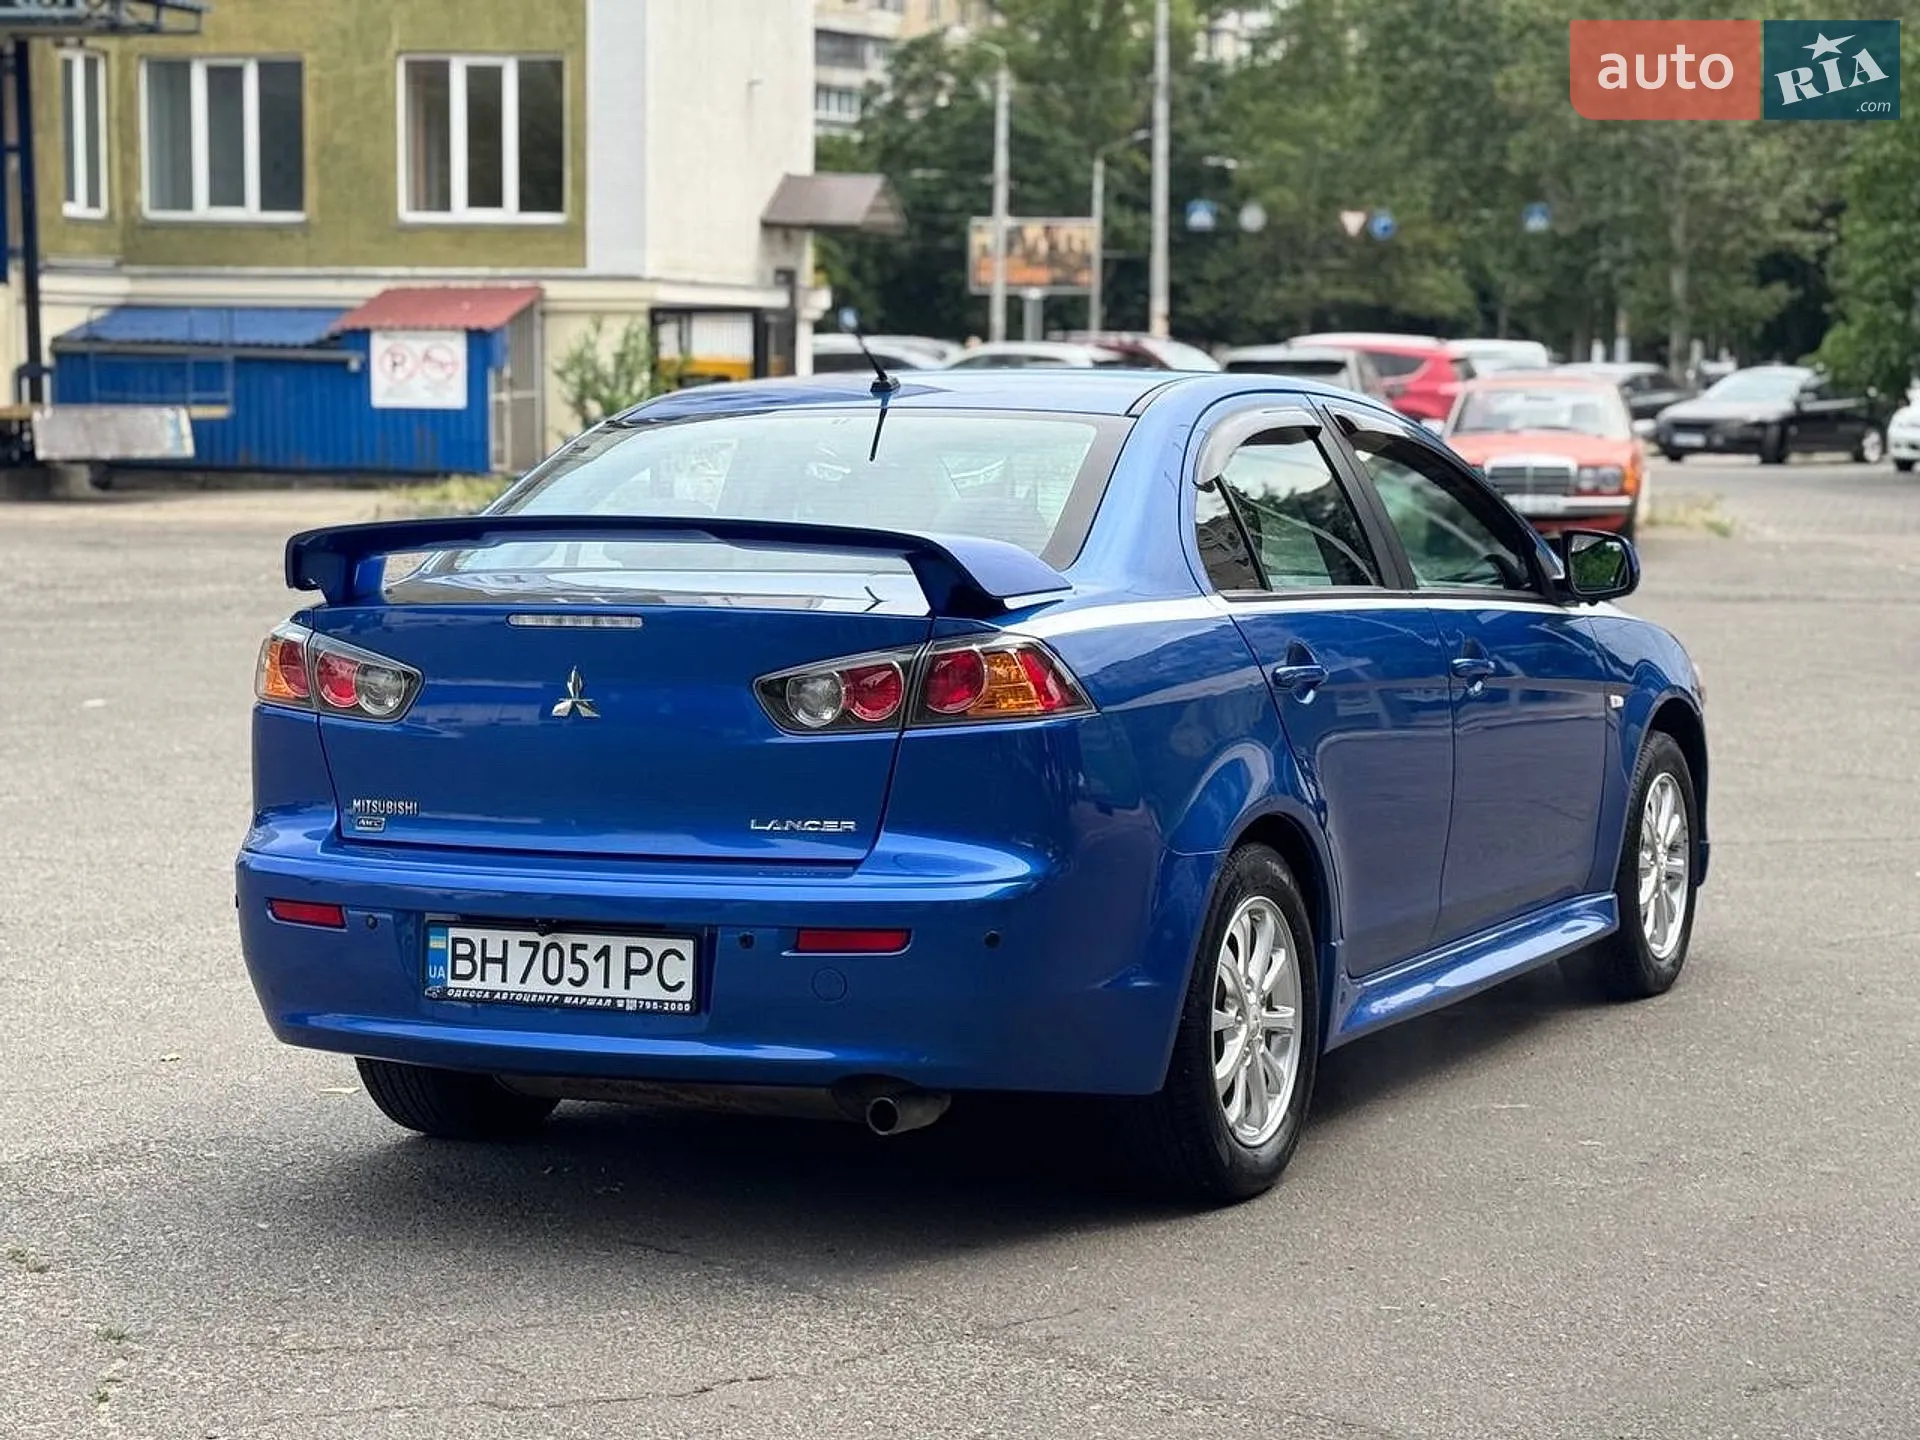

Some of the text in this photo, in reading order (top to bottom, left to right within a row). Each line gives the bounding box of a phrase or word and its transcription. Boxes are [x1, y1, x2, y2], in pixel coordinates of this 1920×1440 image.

[352, 798, 418, 815] MITSUBISHI
[750, 819, 857, 832] LANCER
[428, 964, 446, 980] UA
[447, 988, 490, 999] ОДЕССА
[493, 991, 560, 1004] АВТОЦЕНТР
